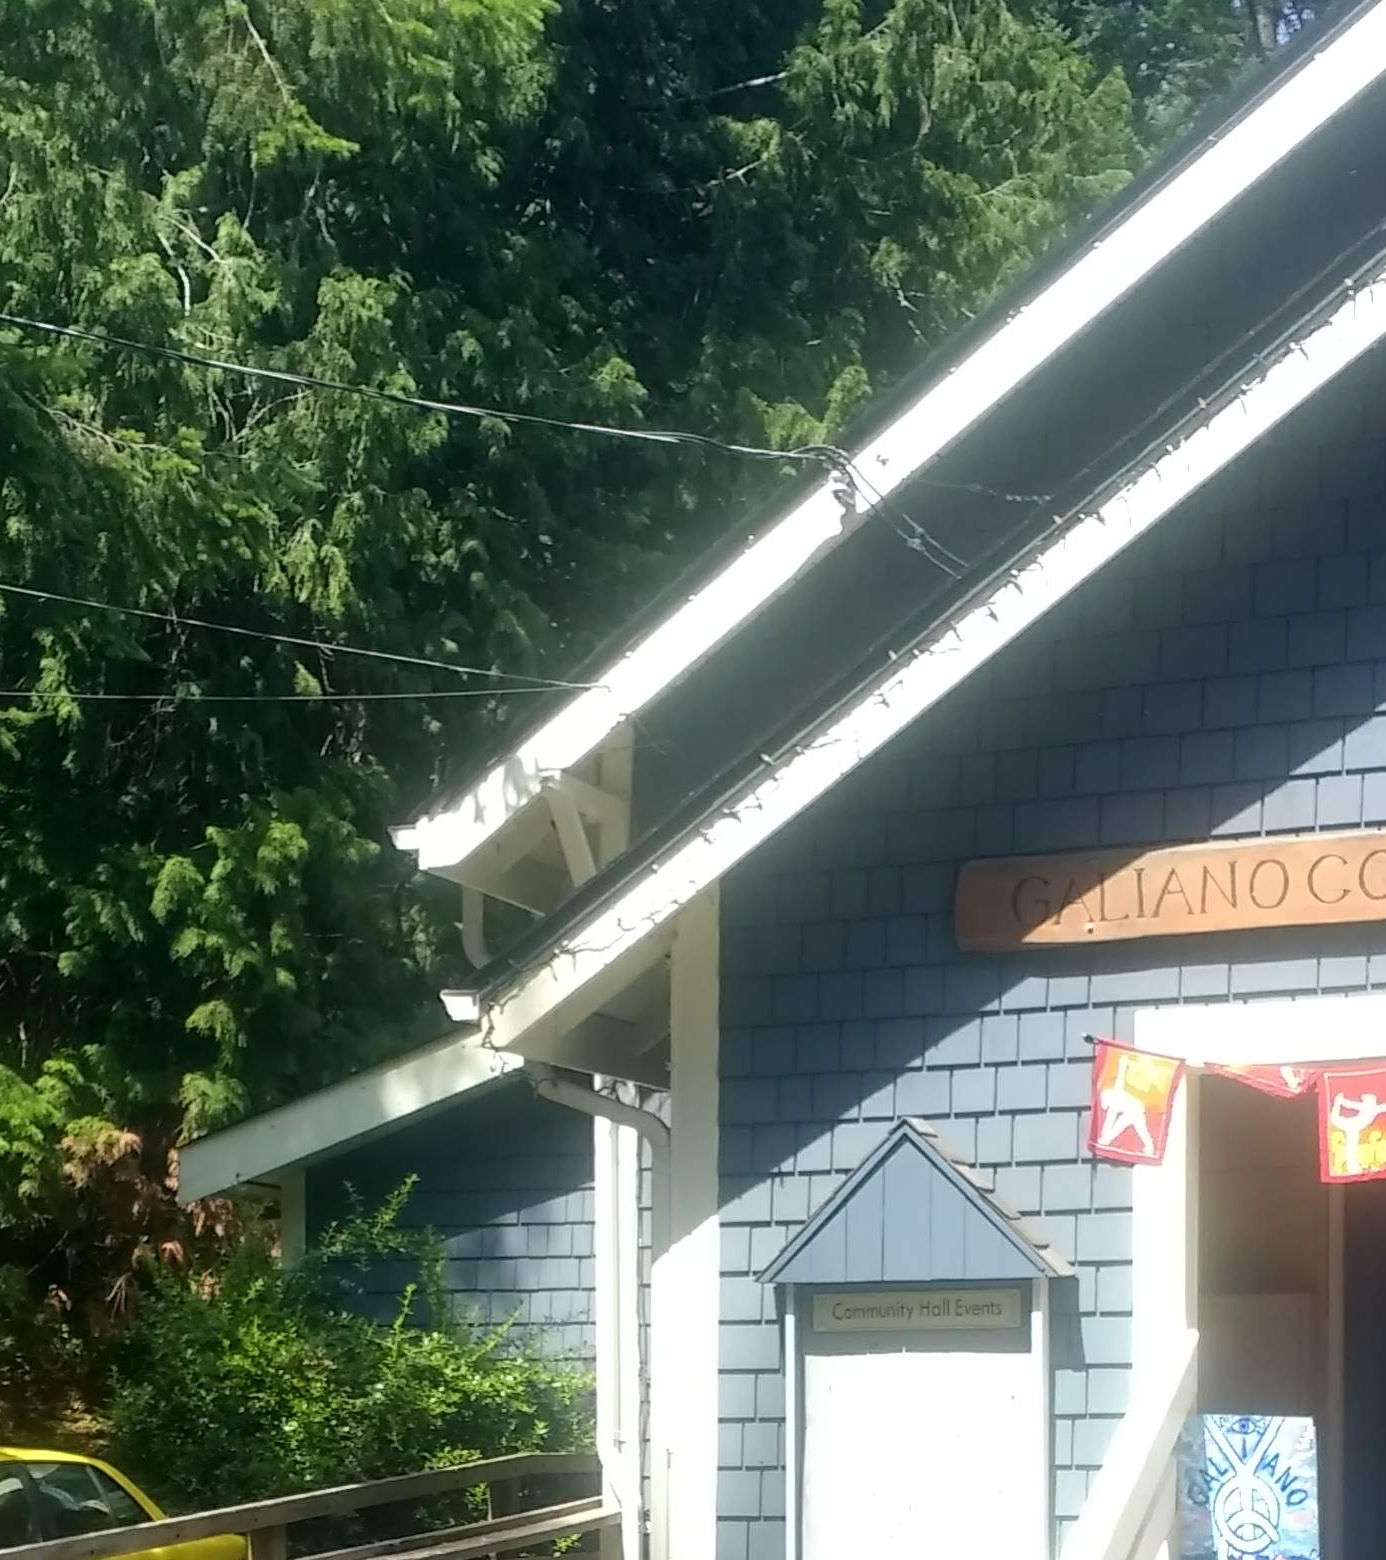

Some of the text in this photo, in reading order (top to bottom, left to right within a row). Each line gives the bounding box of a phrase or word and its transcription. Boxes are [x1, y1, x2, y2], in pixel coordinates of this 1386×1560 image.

[1012, 858, 1290, 926] GALIANO
[832, 1298, 1003, 1321] Community Hall Events
